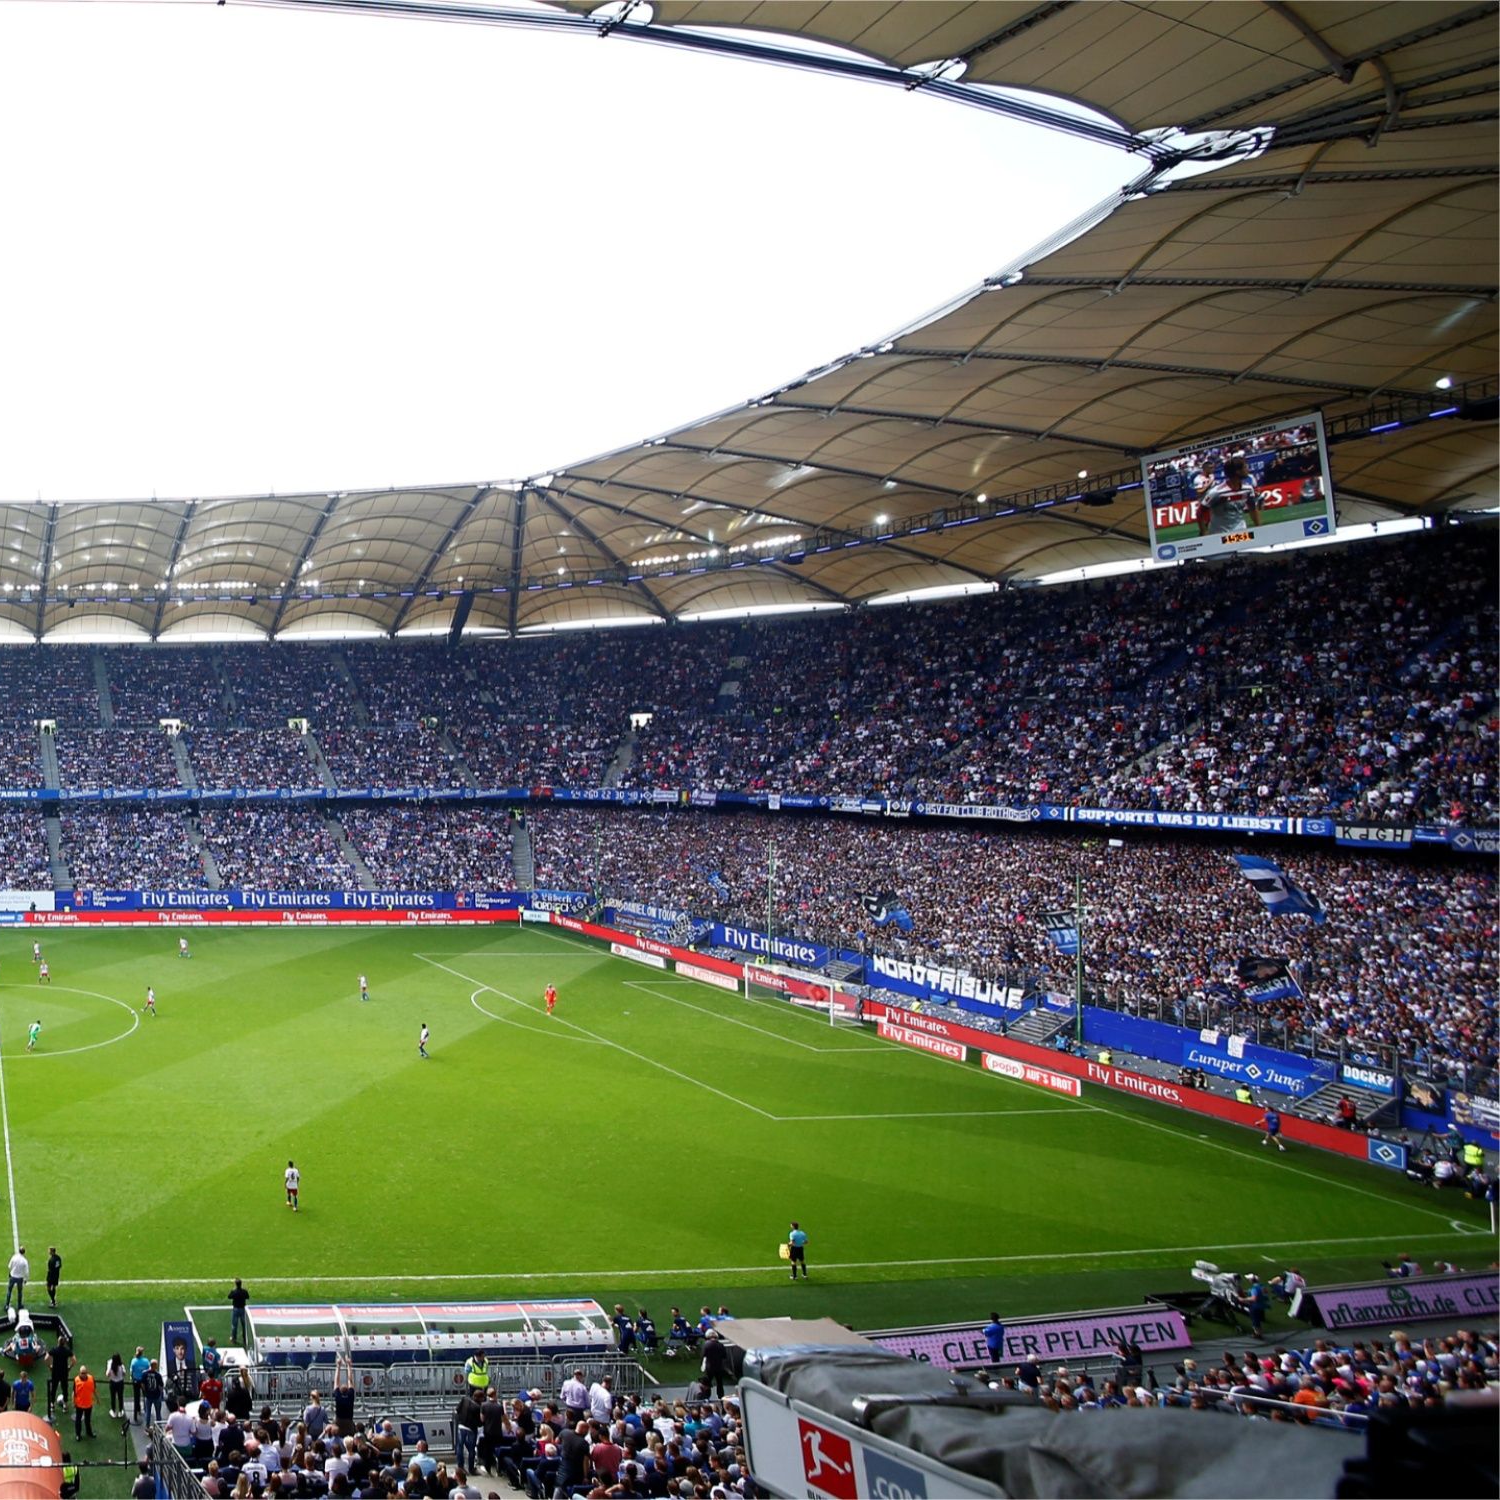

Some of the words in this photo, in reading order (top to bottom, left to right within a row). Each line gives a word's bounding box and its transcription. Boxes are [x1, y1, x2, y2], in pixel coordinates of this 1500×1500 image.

[1156, 505, 1187, 527] Fly
[944, 805, 959, 815] FAN
[1078, 809, 1154, 823] SUPPORTE
[1156, 811, 1193, 826] WAS
[1197, 815, 1218, 827] DU
[1222, 817, 1284, 831] LIEBST
[142, 892, 165, 907] Fly
[168, 892, 229, 905] Emirates
[242, 892, 266, 907] Fly
[268, 891, 331, 906] Emirates
[343, 892, 368, 908] Fly
[371, 891, 434, 906] Emirates
[34, 914, 46, 924] Fly
[158, 913, 170, 922] Fly
[283, 912, 294, 922] Fly
[407, 912, 419, 922] Fly
[724, 927, 747, 950] Fly
[750, 932, 816, 962] Emirates
[885, 1007, 900, 1024] Fly
[883, 1023, 903, 1041] Fly
[905, 1030, 960, 1057] Emirates
[992, 1060, 1019, 1074] popp
[1188, 1049, 1244, 1077] Luruper
[1087, 1062, 1110, 1083] Fly
[1114, 1069, 1183, 1102] Emirates.
[1342, 1064, 1394, 1088] DOCK87
[1045, 1320, 1178, 1352] PFLANZEN
[252, 1471, 260, 1485] 8
